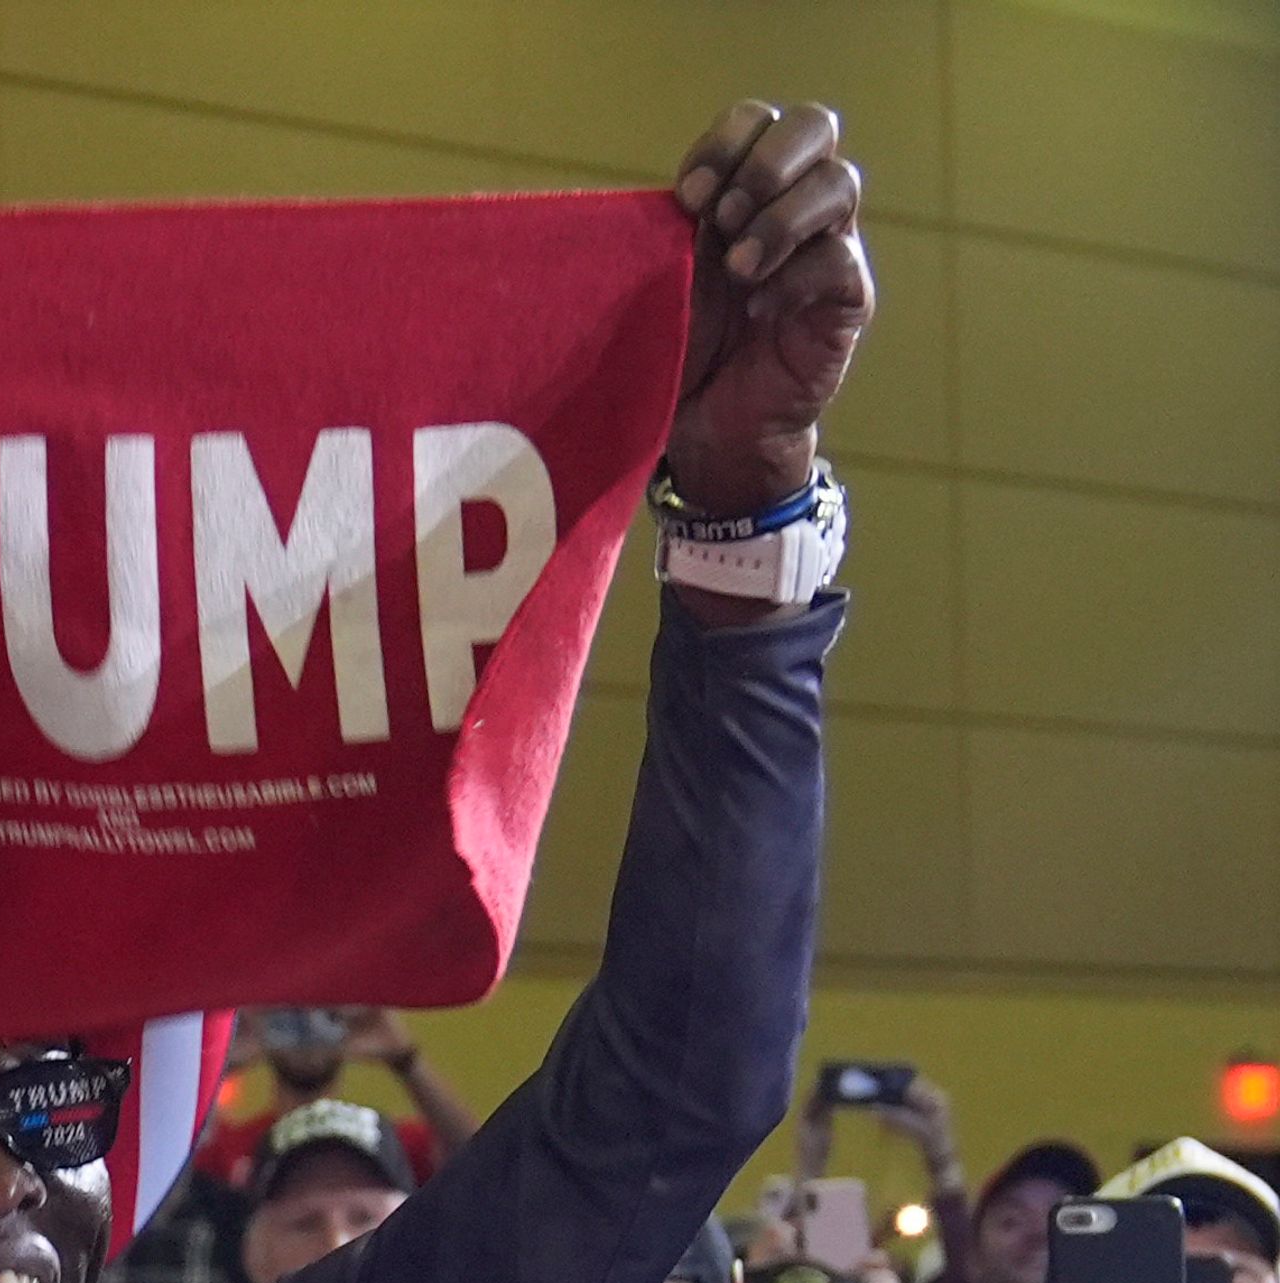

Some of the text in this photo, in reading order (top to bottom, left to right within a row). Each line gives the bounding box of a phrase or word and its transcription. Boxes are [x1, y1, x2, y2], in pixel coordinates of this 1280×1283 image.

[692, 516, 755, 541] BLUE
[33, 776, 62, 806] BY
[9, 1075, 106, 1113] TRUMP
[42, 1120, 86, 1148] 2024
